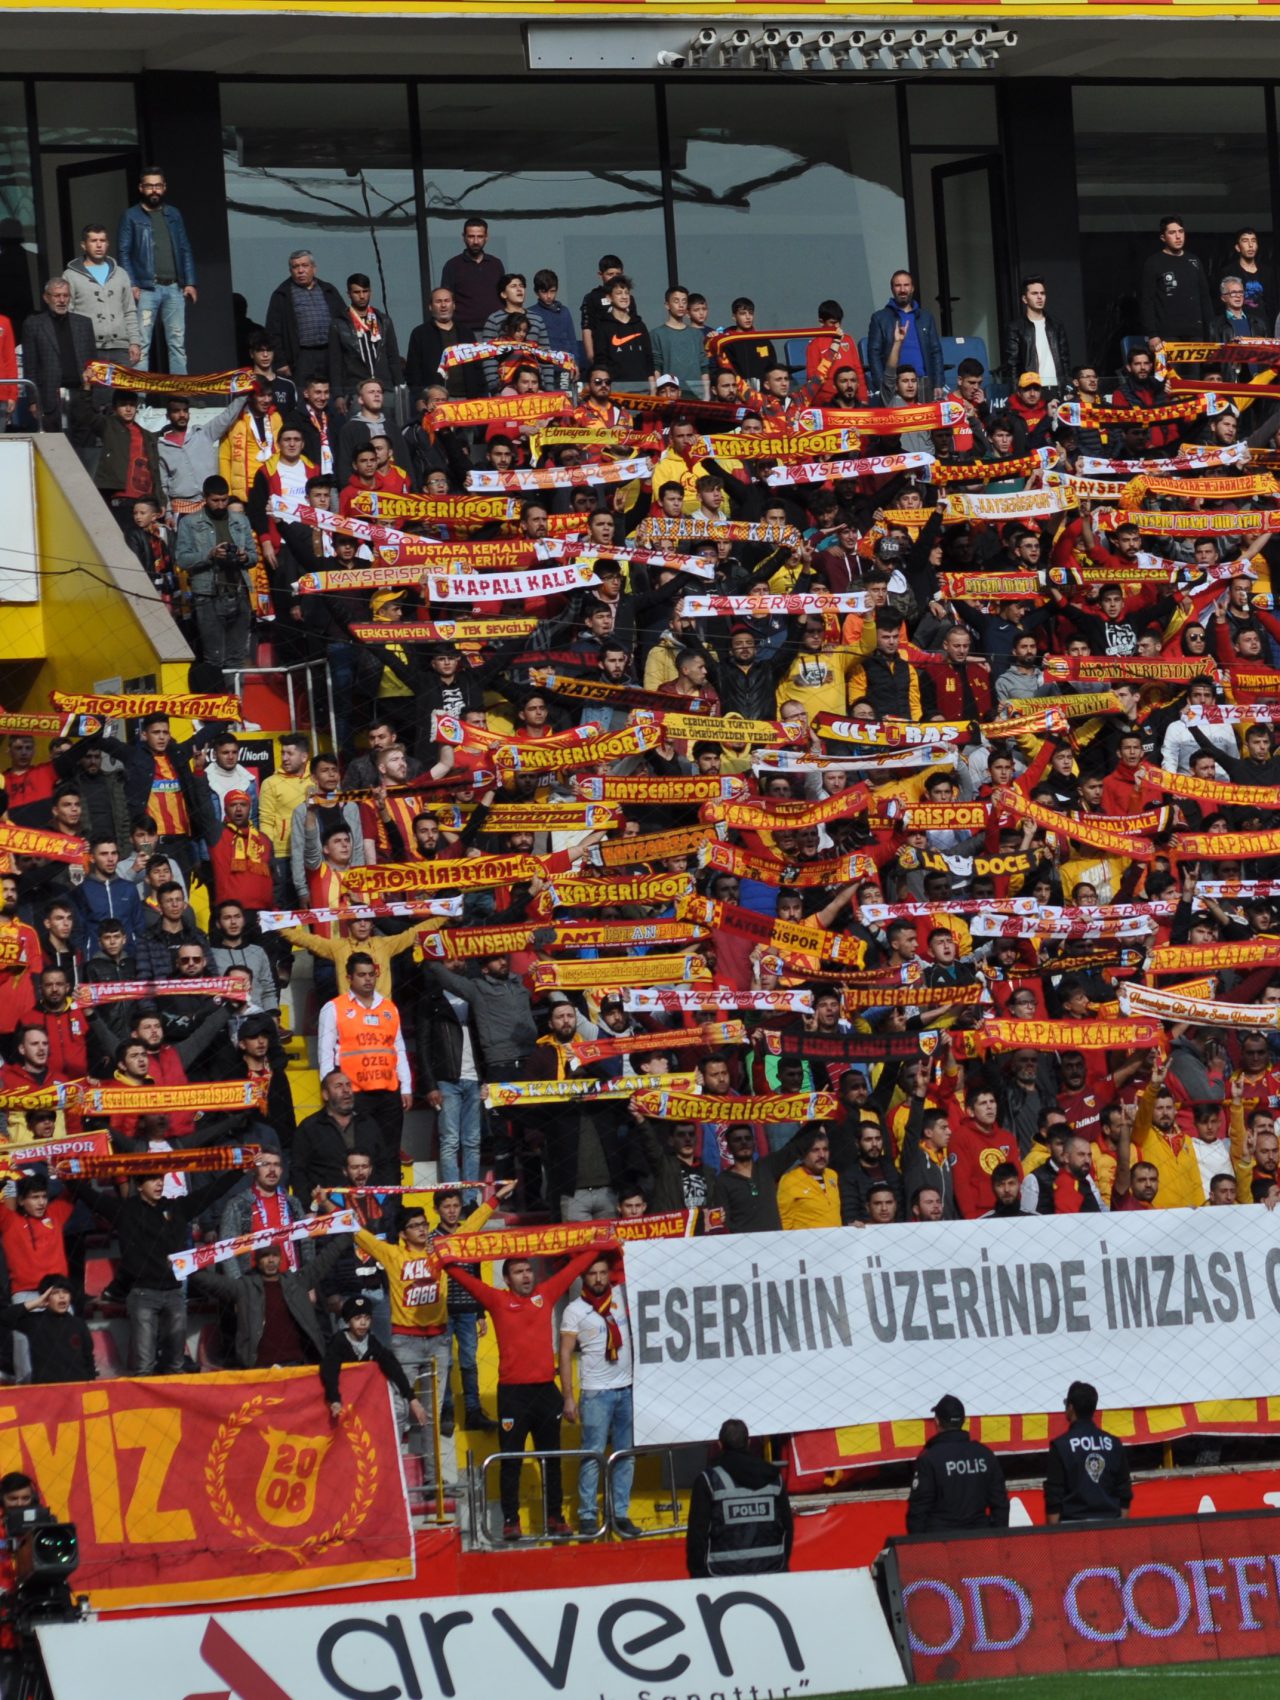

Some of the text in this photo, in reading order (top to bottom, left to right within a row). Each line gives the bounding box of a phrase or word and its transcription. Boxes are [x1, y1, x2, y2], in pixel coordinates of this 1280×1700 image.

[453, 568, 578, 597] KAPALI KALE
[974, 854, 1029, 876] DOCE
[405, 1284, 438, 1307] 1966
[637, 1260, 852, 1365] ESERİNİN
[863, 1255, 1091, 1344] ÜZERİNDE
[1100, 1239, 1257, 1331] İMZASI
[1070, 1434, 1113, 1453] POLİS
[276, 1444, 317, 1473] 20
[946, 1459, 988, 1476] POLİS
[266, 1479, 308, 1511] 08
[731, 1501, 766, 1517] POLİS
[317, 1591, 805, 1700] arven
